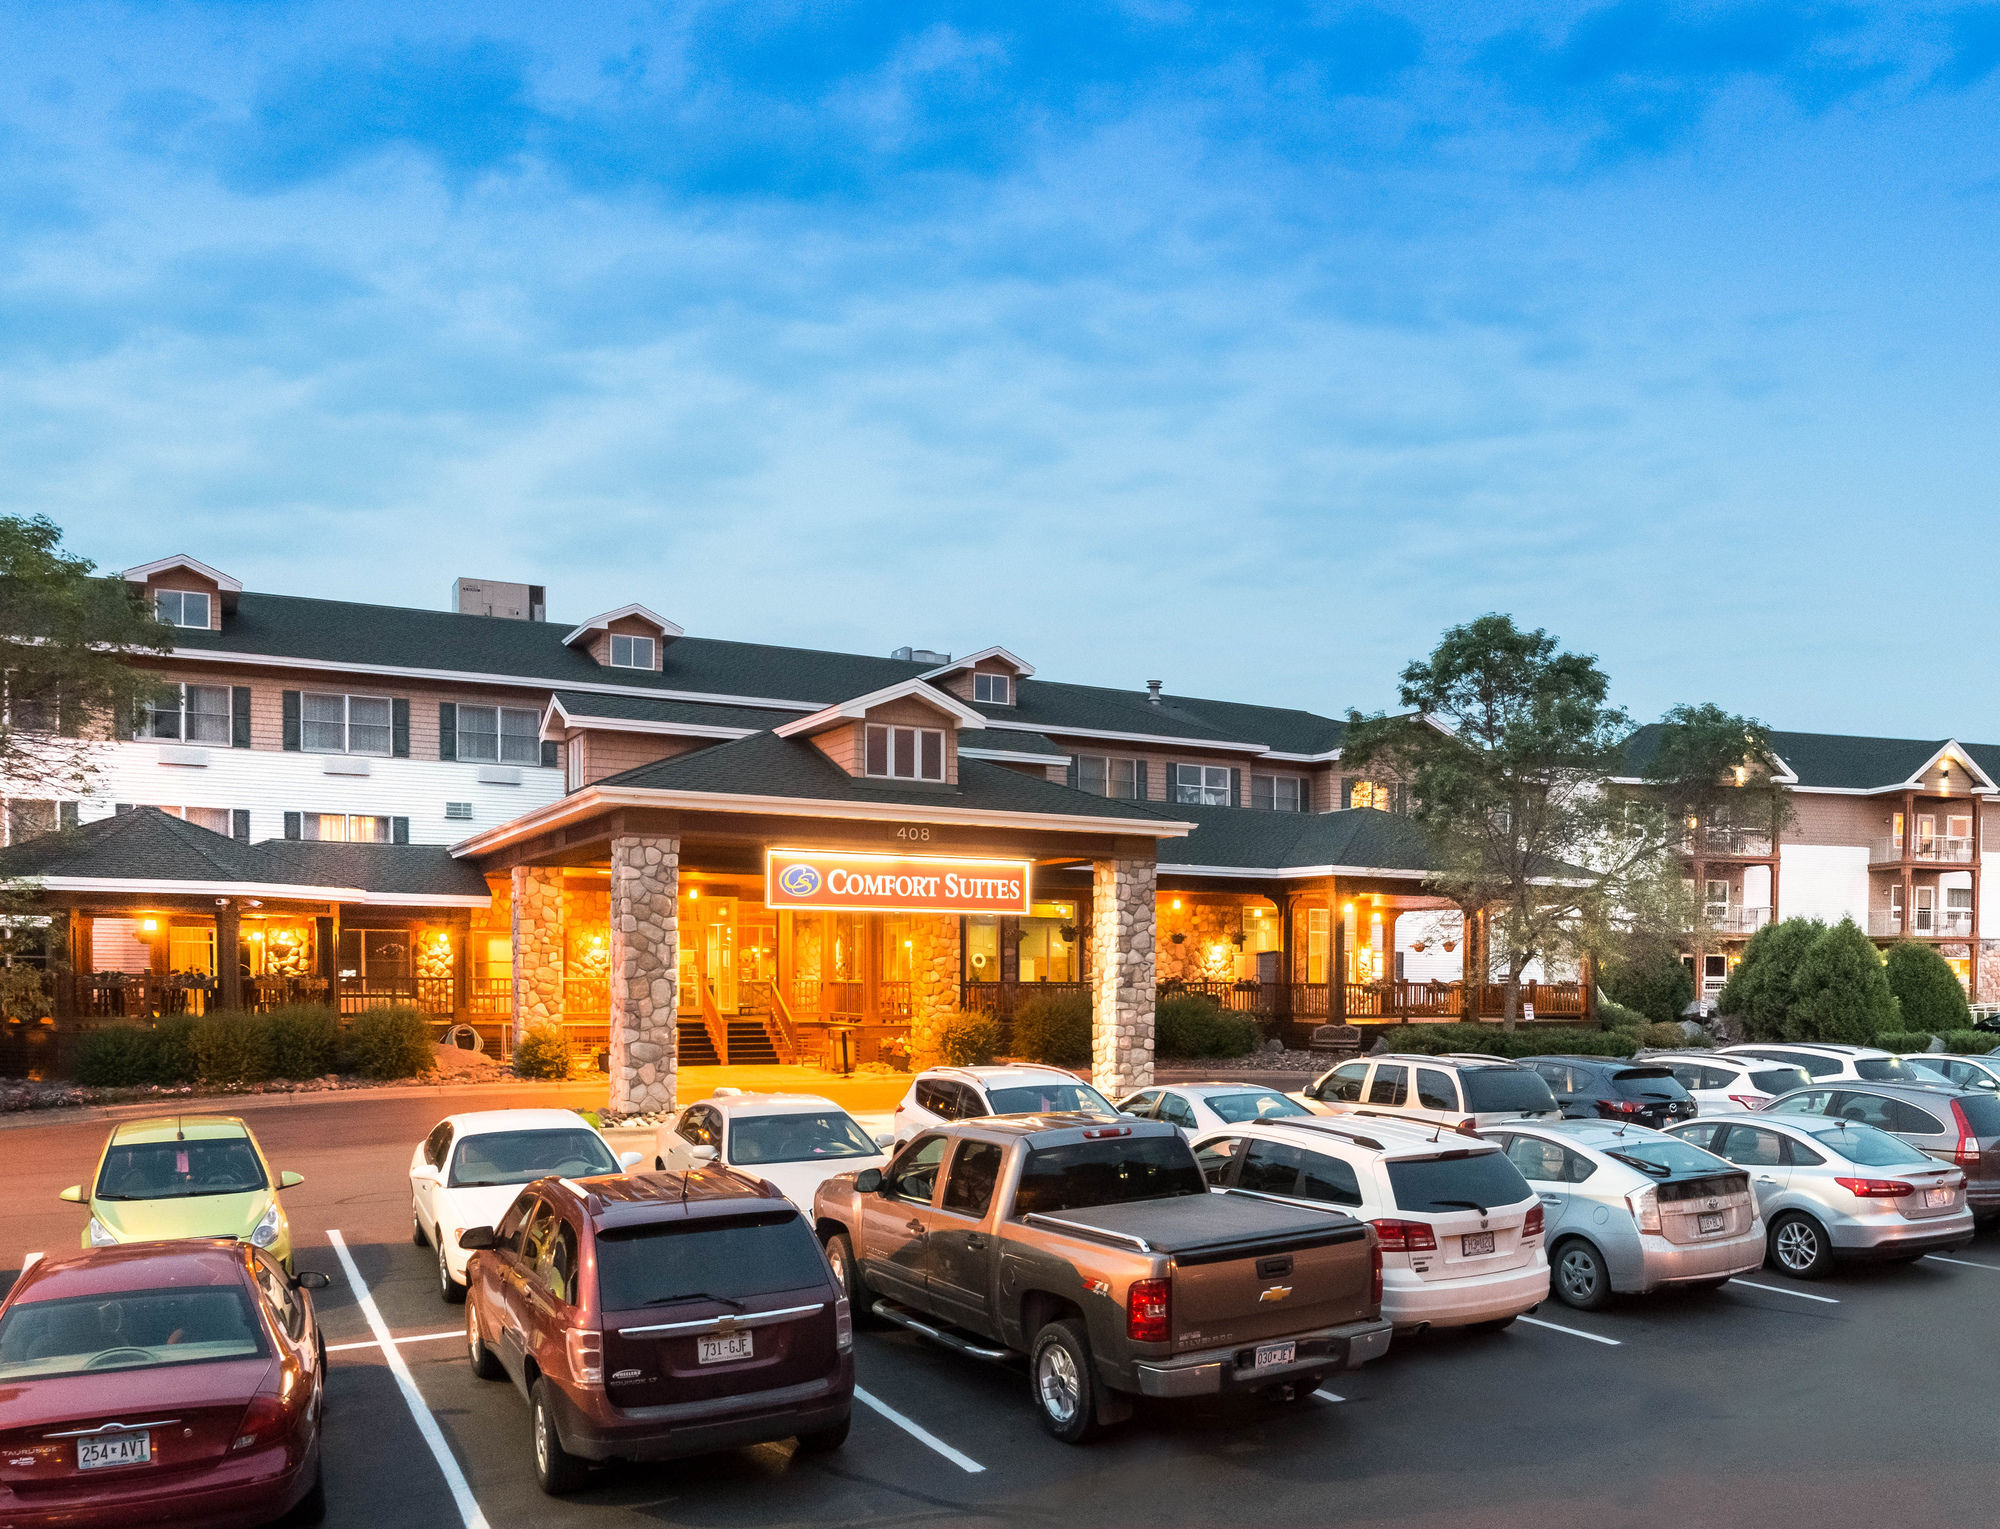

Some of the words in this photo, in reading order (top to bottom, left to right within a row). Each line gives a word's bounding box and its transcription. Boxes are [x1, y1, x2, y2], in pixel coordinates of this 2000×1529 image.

[896, 827, 931, 841] 408
[827, 868, 940, 897] COMFORT
[944, 872, 1021, 900] SUITES
[703, 1338, 748, 1357] 731-GJF
